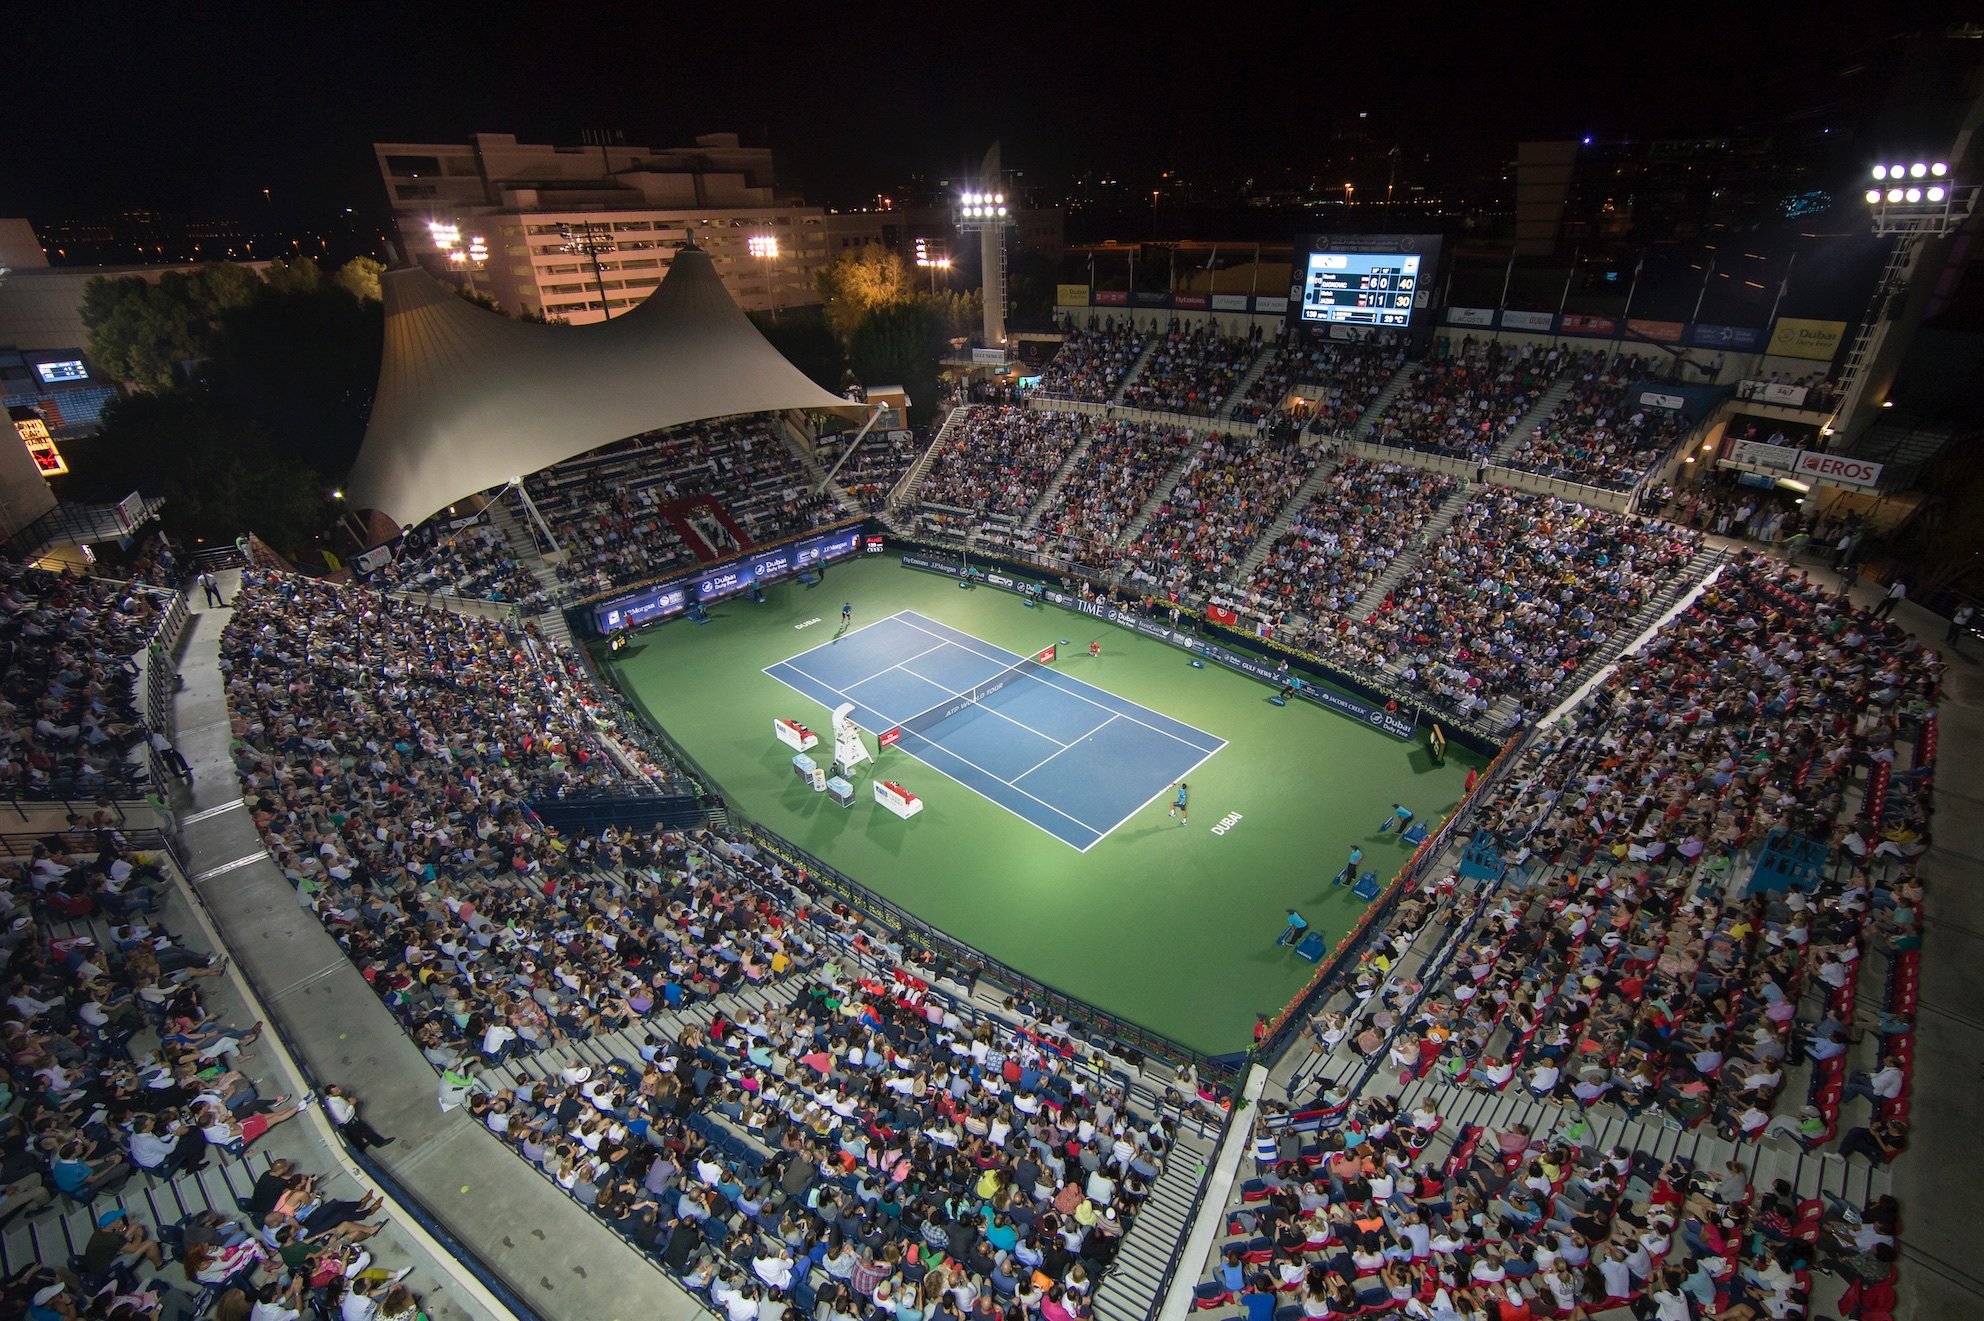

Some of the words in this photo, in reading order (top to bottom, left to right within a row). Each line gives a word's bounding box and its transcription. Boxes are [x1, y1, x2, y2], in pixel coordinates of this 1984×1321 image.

[1371, 278, 1377, 288] 6
[1380, 278, 1387, 288] 0
[1400, 279, 1413, 289] 40
[1369, 295, 1374, 305] 1
[1378, 296, 1384, 305] 1
[1396, 296, 1410, 306] 30
[1800, 329, 1836, 341] Dubai
[1820, 458, 1874, 480] EROS
[766, 558, 787, 568] Dubai
[910, 558, 928, 566] Emirates
[930, 562, 956, 573] J.P.Morgan
[714, 574, 736, 584] Dubai
[1078, 599, 1104, 618] TIME
[794, 617, 822, 630] DUBAI
[1118, 612, 1136, 624] Dubai
[1242, 662, 1255, 672] GULF
[1256, 666, 1272, 678] NEWS
[945, 706, 960, 717] ATP
[986, 682, 1004, 696] TOUR
[1385, 715, 1411, 732] Dubai
[1383, 723, 1395, 733] Duty
[1396, 729, 1408, 738] Free
[1210, 811, 1243, 836] DUBAI
